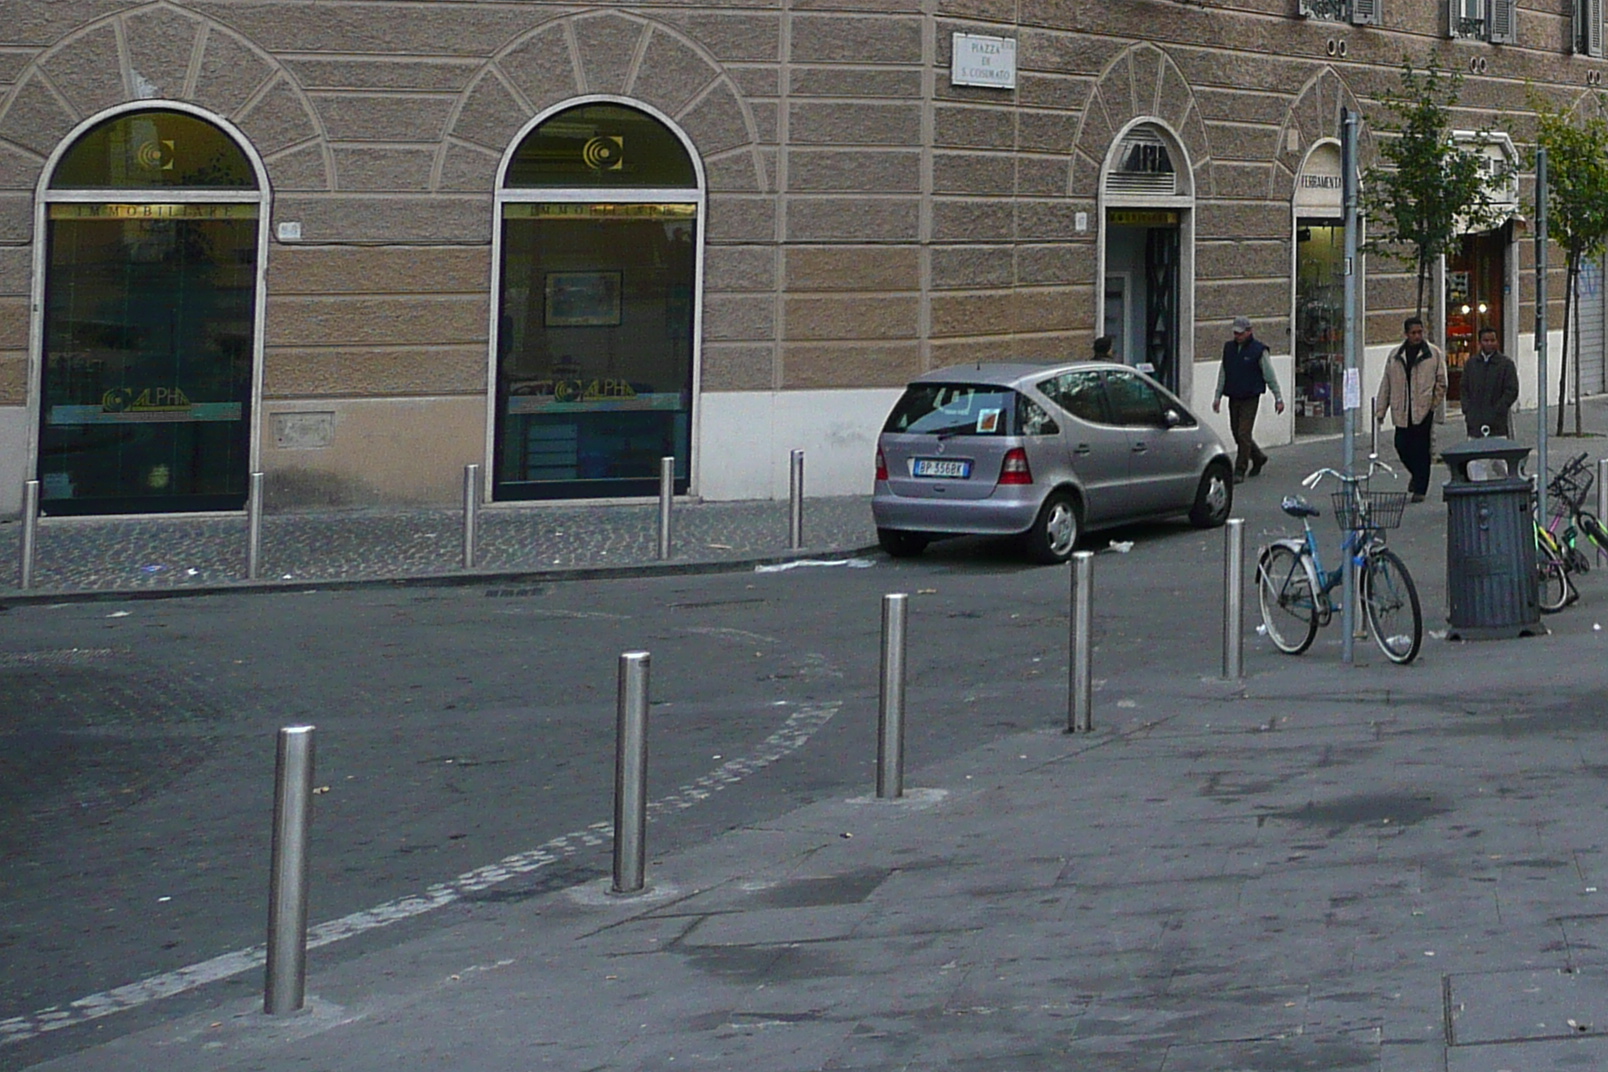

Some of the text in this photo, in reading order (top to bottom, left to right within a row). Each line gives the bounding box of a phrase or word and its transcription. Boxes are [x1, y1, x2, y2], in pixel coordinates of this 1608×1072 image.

[971, 42, 1000, 54] PIAZZA
[981, 56, 991, 66] DI
[77, 204, 233, 217] IMMOBILIARE
[584, 379, 637, 397] ALPHA
[133, 386, 191, 406] ALPHA
